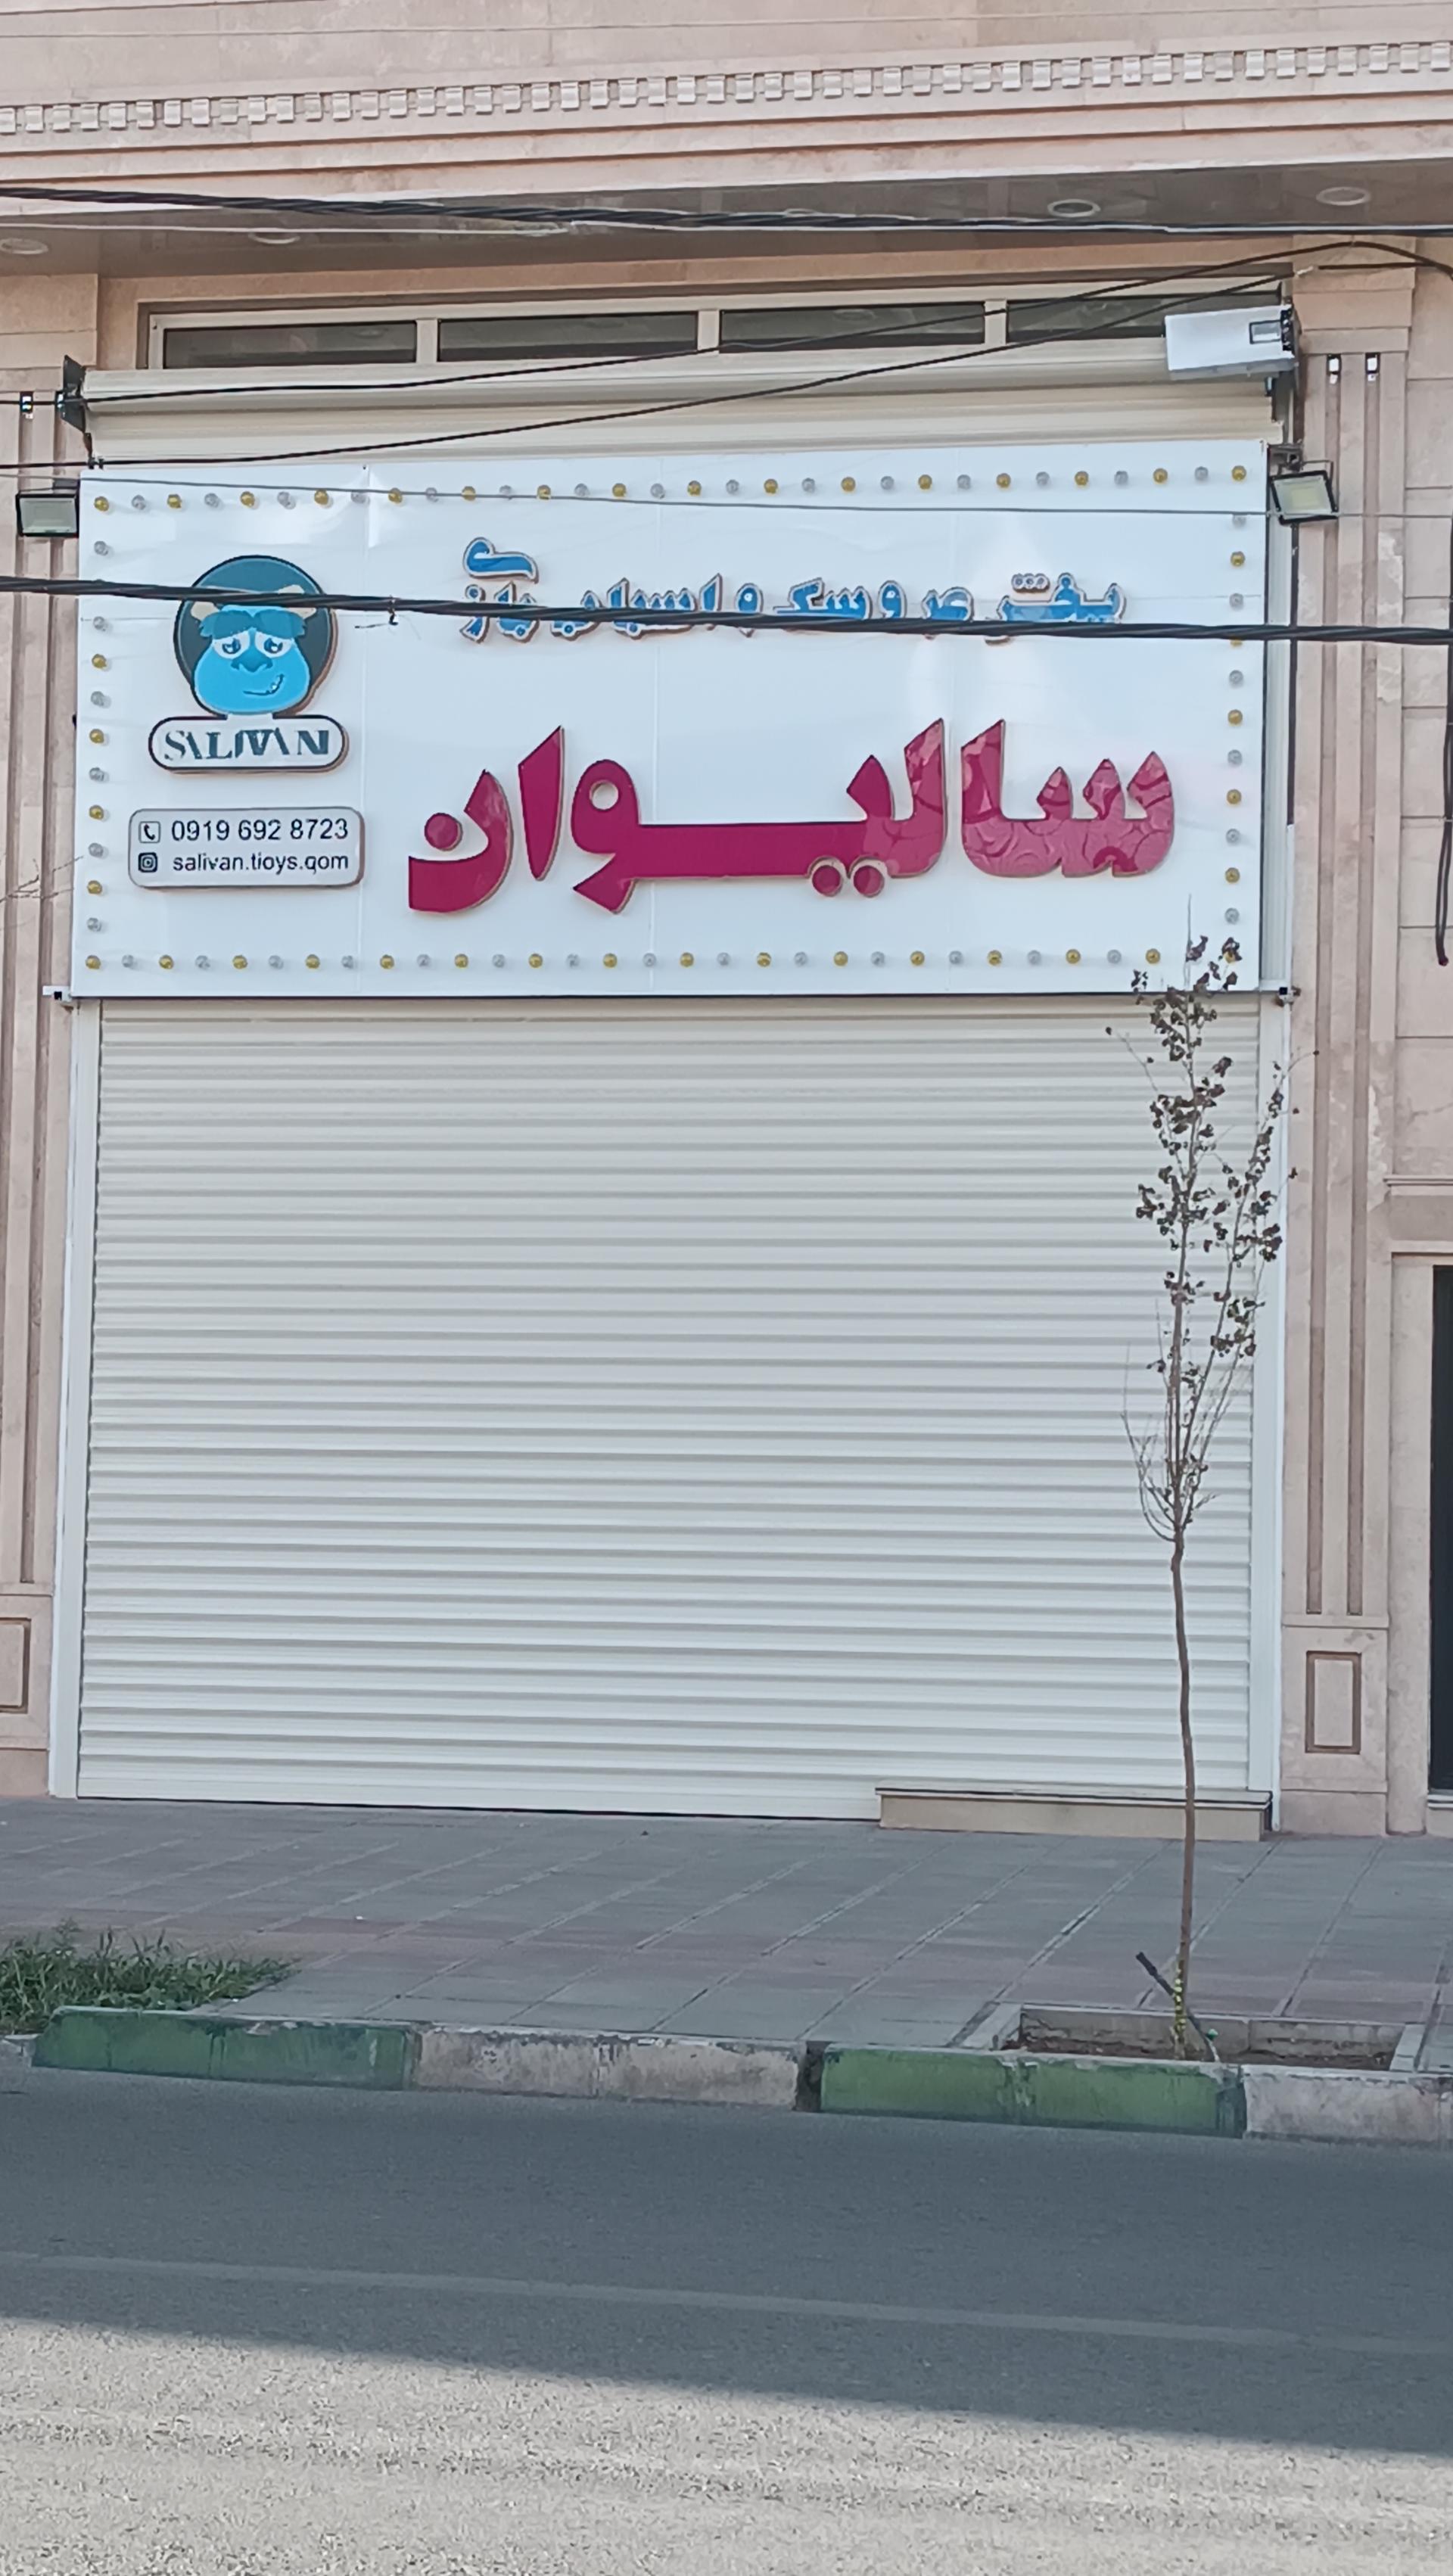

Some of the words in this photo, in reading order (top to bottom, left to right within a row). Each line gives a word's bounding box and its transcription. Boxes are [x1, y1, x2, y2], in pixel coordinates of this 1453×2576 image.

[736, 582, 764, 638] و
[164, 727, 330, 761] SALIVAN
[172, 819, 230, 842] 0919
[238, 819, 282, 841] 692
[290, 818, 349, 840] 8723
[408, 717, 1175, 914] سالیوان
